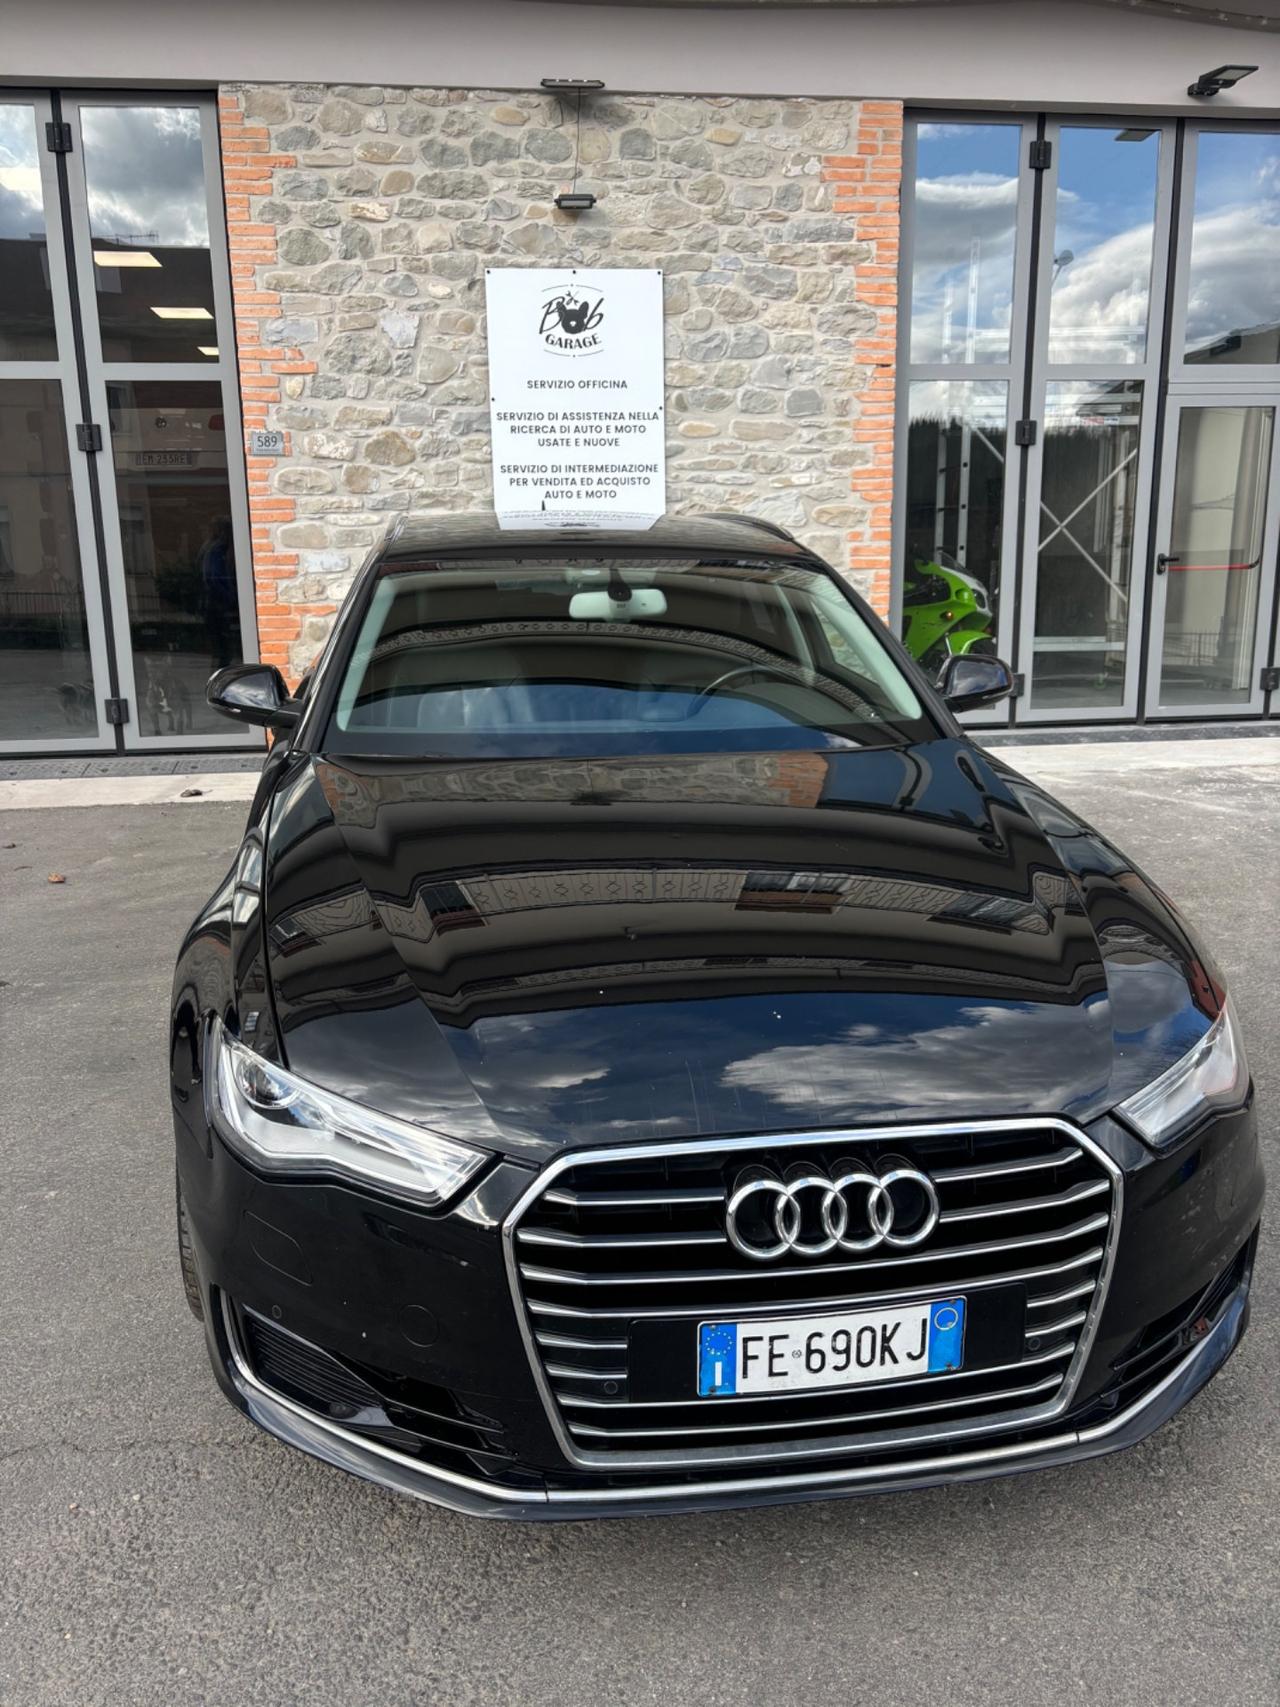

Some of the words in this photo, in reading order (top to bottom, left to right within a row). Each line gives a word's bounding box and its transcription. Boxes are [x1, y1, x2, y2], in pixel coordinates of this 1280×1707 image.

[545, 333, 602, 349] GARAGE
[527, 380, 575, 389] SERVIZIO
[578, 380, 628, 389] OFFICINA
[496, 412, 545, 421] SERVIZIO
[548, 412, 558, 421] DI
[561, 412, 625, 421] ASSISTENZA
[629, 412, 659, 421] NELLA
[510, 425, 556, 434] RICERCA
[560, 425, 570, 434] DI
[574, 425, 602, 434] AUTO
[606, 425, 611, 434] E
[615, 425, 646, 434] MOTO
[257, 436, 278, 447] 589
[538, 438, 571, 447] USATE
[575, 438, 580, 447] E
[583, 438, 620, 447] NUOVE
[500, 465, 548, 474] SERVIZIO
[551, 465, 562, 473] DI
[565, 464, 659, 473] INTERMEDIAZIONE
[510, 478, 528, 487] PER
[532, 478, 577, 486] VENDITA
[581, 478, 593, 486] ED
[597, 477, 651, 487] ACQUISTO
[545, 490, 574, 499] AUTO
[577, 490, 582, 499] E
[586, 490, 617, 499] MOTO
